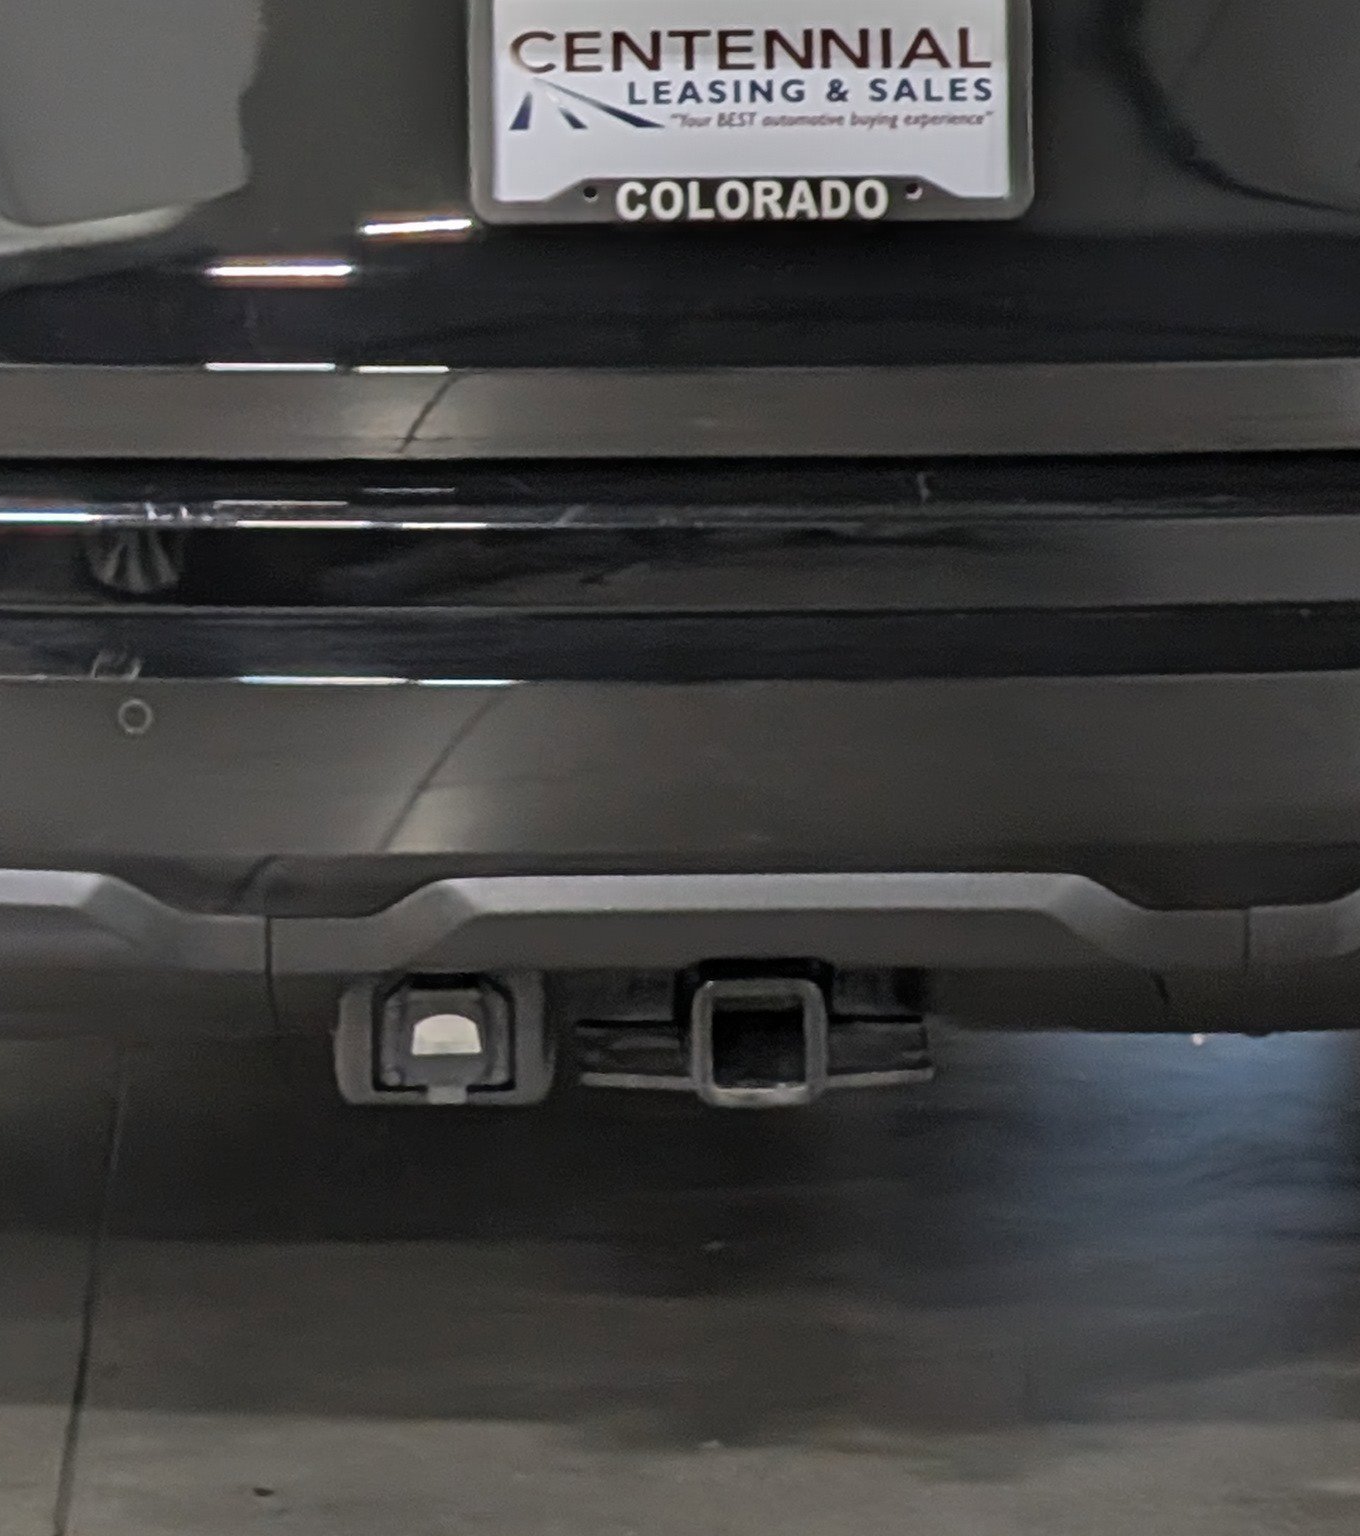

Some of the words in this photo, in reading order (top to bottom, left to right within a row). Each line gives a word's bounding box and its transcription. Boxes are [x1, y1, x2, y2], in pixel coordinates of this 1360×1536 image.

[508, 27, 993, 73] CENTENNIAL
[628, 79, 806, 106] LEASING
[826, 79, 850, 103] &
[869, 77, 994, 103] SALES
[717, 112, 757, 127] BEST
[762, 115, 844, 126] automotive
[850, 112, 898, 129] buying
[615, 178, 889, 222] COLORADO
